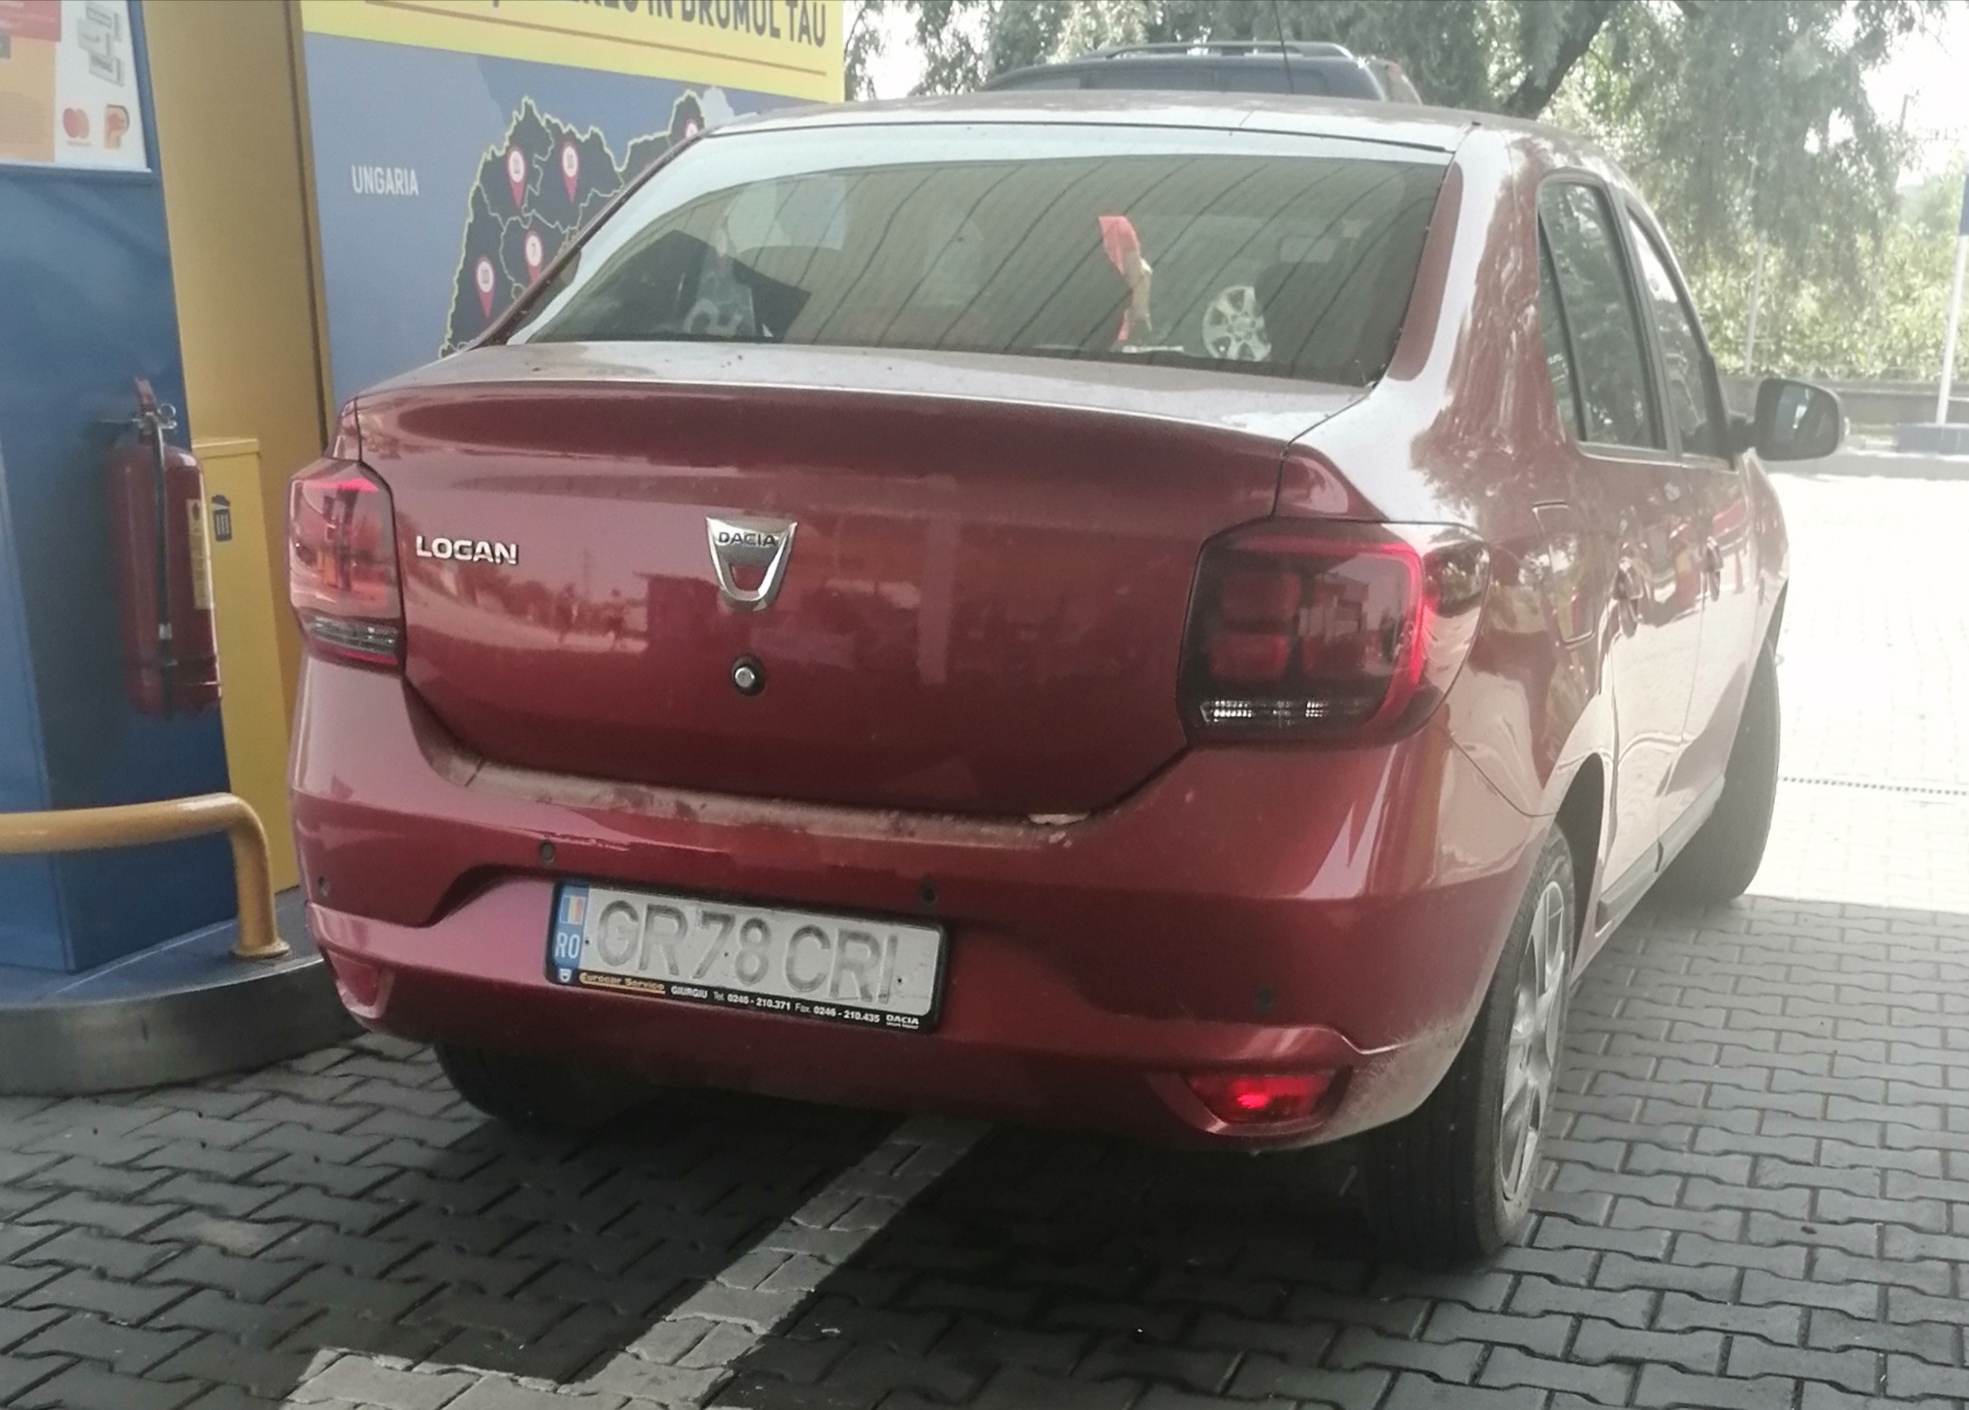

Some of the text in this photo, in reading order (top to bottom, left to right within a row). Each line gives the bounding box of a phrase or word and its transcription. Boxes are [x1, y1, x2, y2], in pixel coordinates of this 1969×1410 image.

[351, 164, 419, 196] UNGARIA
[416, 535, 519, 565] LOGAN
[718, 531, 777, 547] DACIA
[555, 931, 581, 959] RO
[625, 977, 666, 991] Service
[671, 985, 708, 999] GIURGIU
[886, 1013, 919, 1026] DACIA
